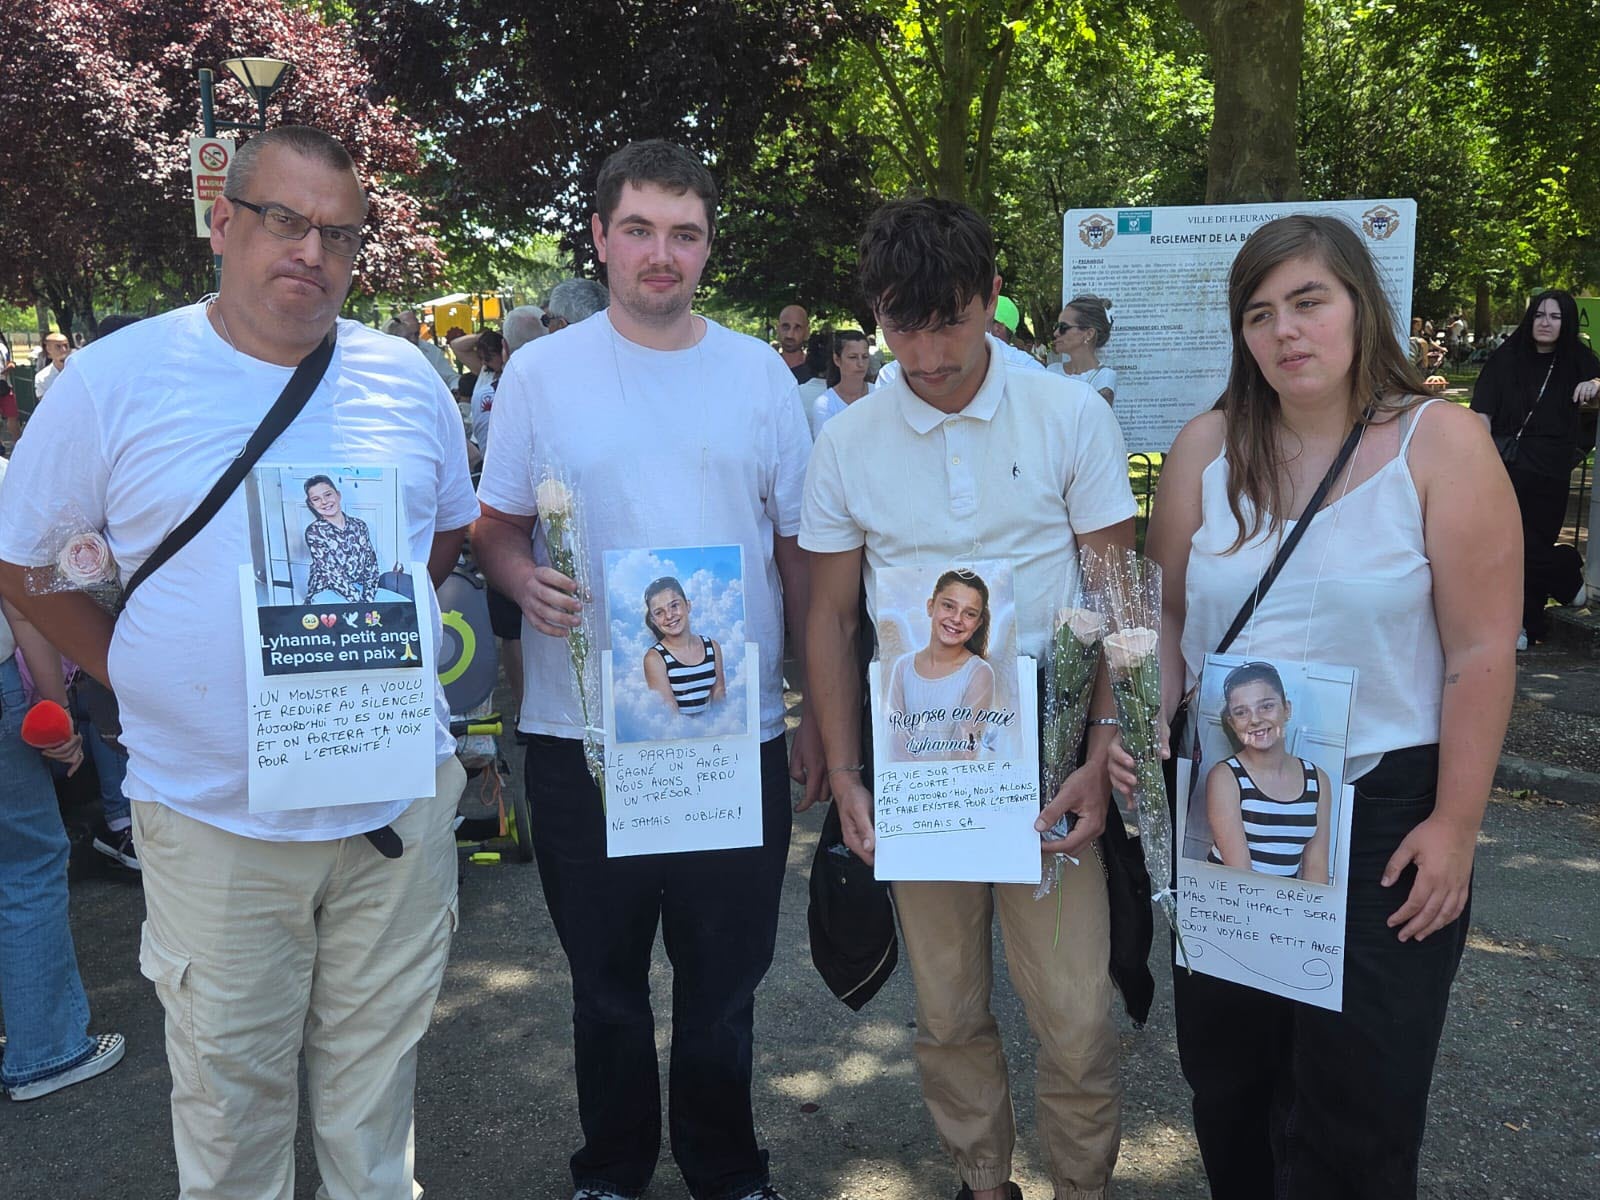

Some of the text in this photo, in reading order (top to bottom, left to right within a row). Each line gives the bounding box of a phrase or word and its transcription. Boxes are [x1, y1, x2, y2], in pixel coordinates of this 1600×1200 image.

[1187, 216, 1213, 225] VILLE
[1215, 215, 1226, 224] DE
[1150, 234, 1206, 245] REGLEMENT
[1209, 234, 1222, 243] DE
[1225, 233, 1237, 242] LA
[261, 631, 419, 651] Lyhanna, petit ange
[271, 647, 396, 667] Repose en paix
[289, 685, 348, 701] MONSTRE
[361, 683, 370, 696] A
[380, 679, 422, 694] VOULU
[254, 710, 272, 722] TE
[339, 700, 355, 711] AU
[333, 717, 349, 727] TU
[354, 713, 370, 722] ES
[378, 711, 394, 721] UN
[401, 707, 432, 719] ANGE
[889, 707, 1016, 733] Repose en paix
[256, 740, 276, 752] ET
[283, 736, 300, 748] ON
[307, 728, 365, 745] PORTERA
[371, 725, 390, 737] TA
[258, 753, 289, 769] POUR
[608, 752, 624, 768] LE
[713, 744, 722, 753] A
[669, 762, 684, 772] UN
[878, 770, 898, 783] TA
[928, 767, 949, 777] SUR
[952, 762, 996, 775] TERRE
[1002, 762, 1012, 770] A
[615, 770, 736, 793] NOUS AVONS PERDU
[973, 786, 994, 795] NOUS
[624, 796, 639, 807] UN
[879, 805, 892, 816] TE
[964, 797, 987, 808] POUR
[612, 817, 625, 831] NE
[877, 821, 903, 833] PLUS
[1179, 876, 1198, 888] TA
[1217, 897, 1240, 907] TON
[1303, 909, 1337, 923] SERA
[1181, 919, 1208, 933] DOUX
[1216, 927, 1260, 942] VOYAGE
[1311, 941, 1342, 955] ANGE
